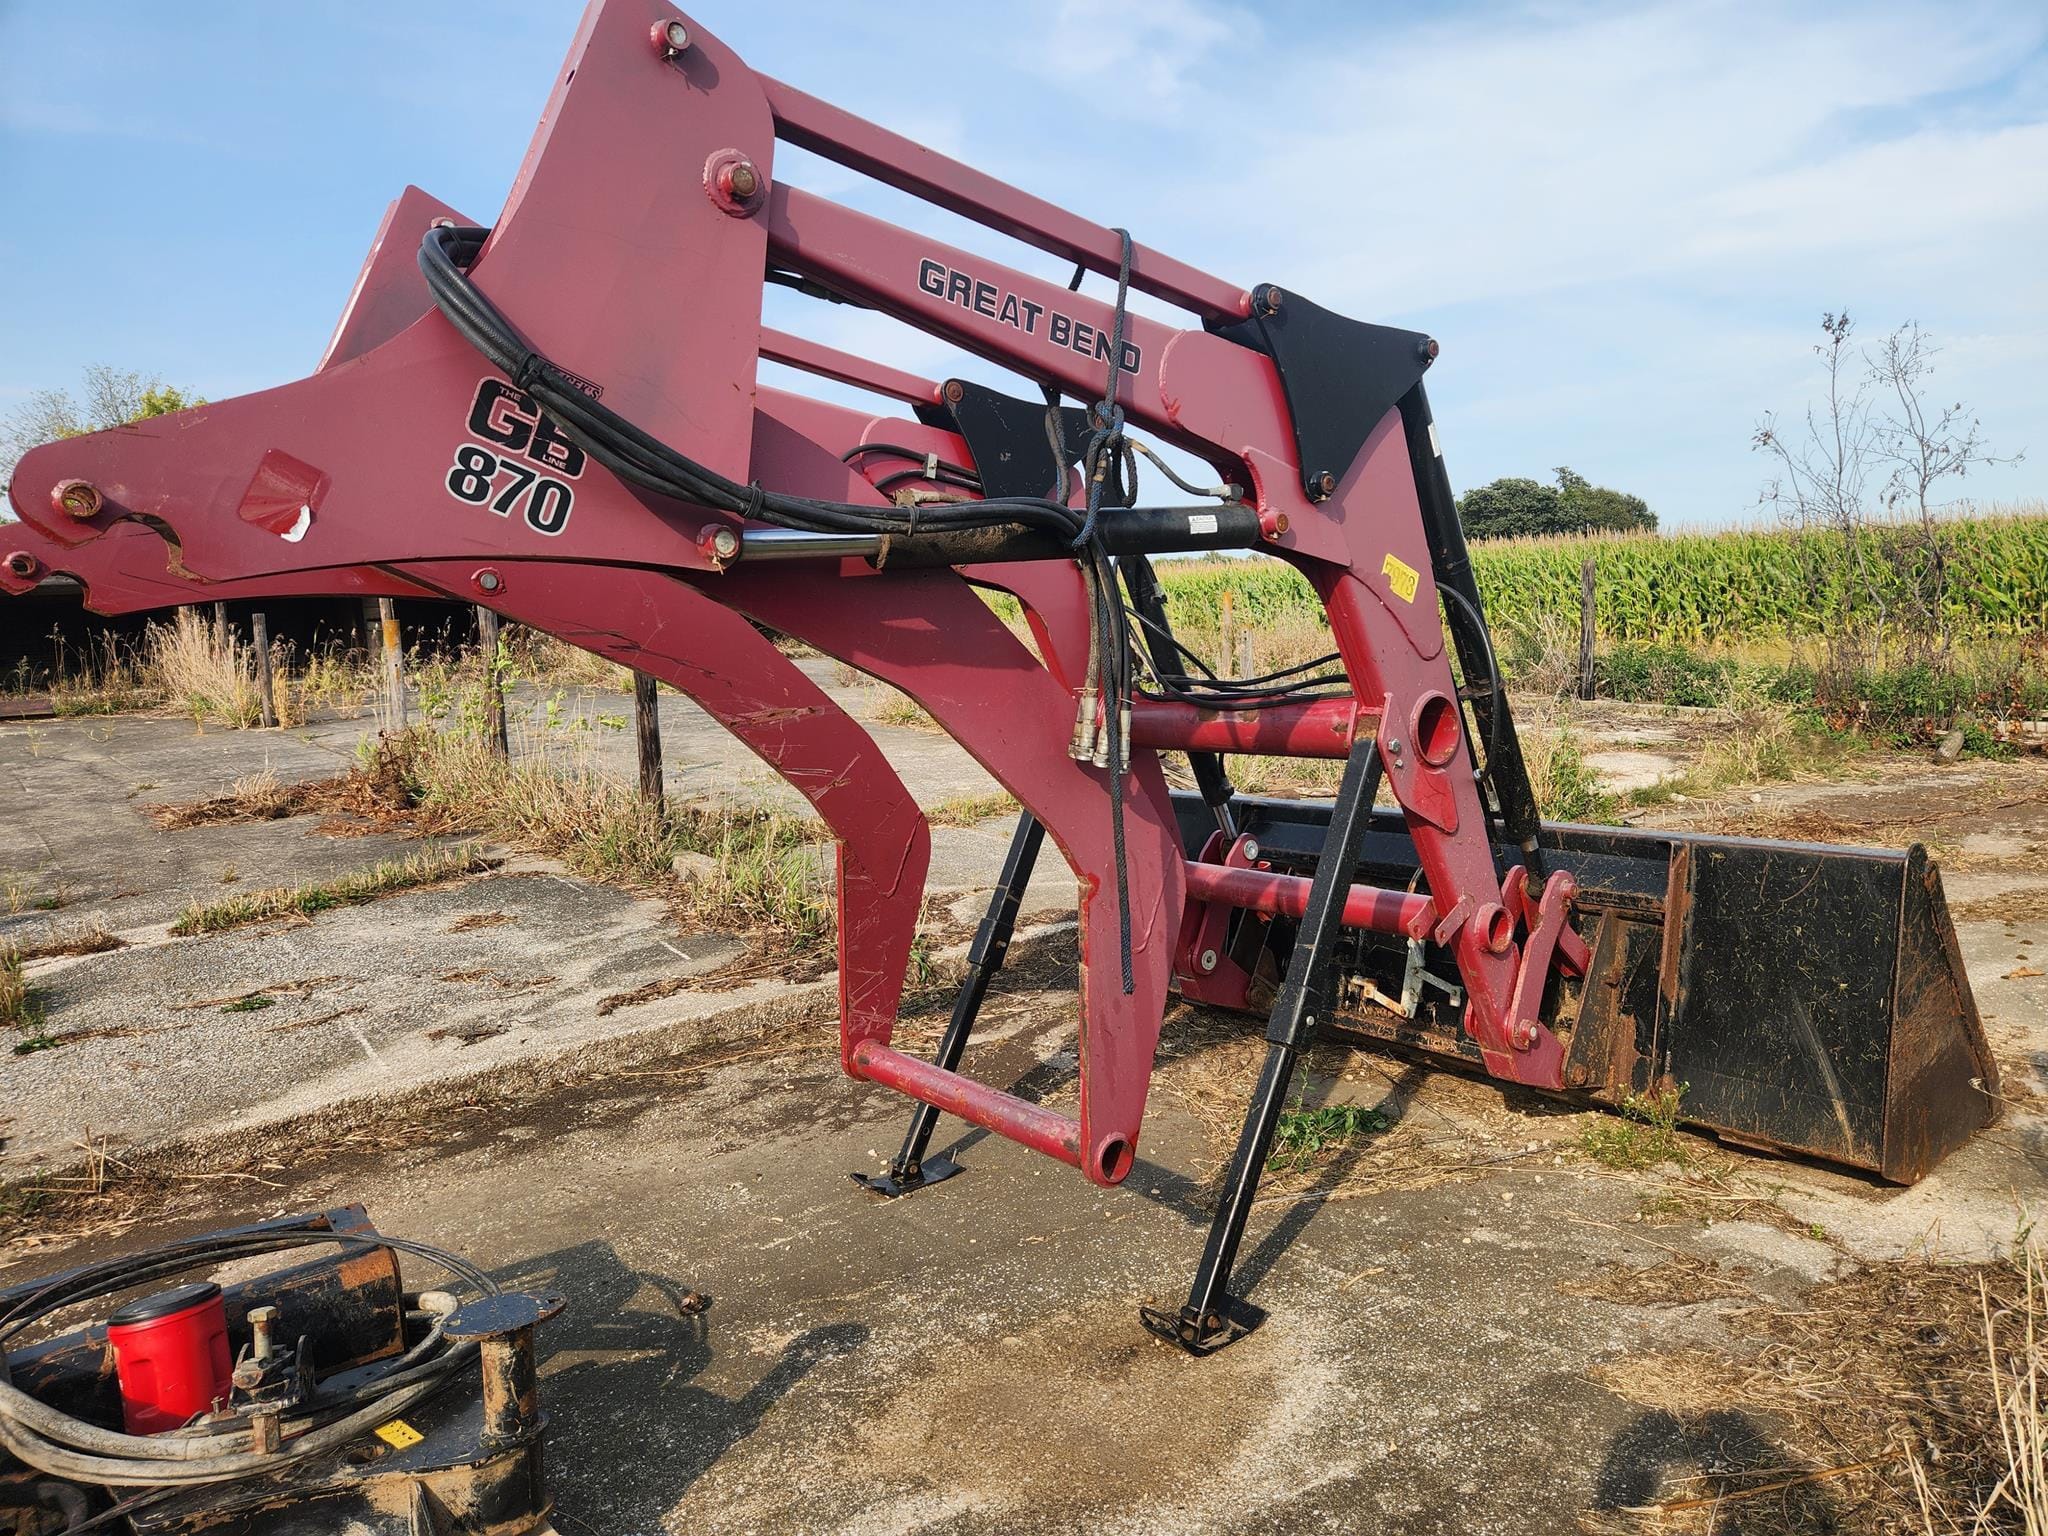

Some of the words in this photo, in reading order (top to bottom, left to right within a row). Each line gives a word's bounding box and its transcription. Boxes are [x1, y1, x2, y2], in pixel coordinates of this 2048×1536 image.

[918, 257, 1044, 335] GREAT
[1048, 311, 1142, 375] BEND
[465, 376, 587, 479] GB
[499, 386, 521, 401] THE
[445, 443, 575, 536] 870
[542, 454, 567, 470] LINE
